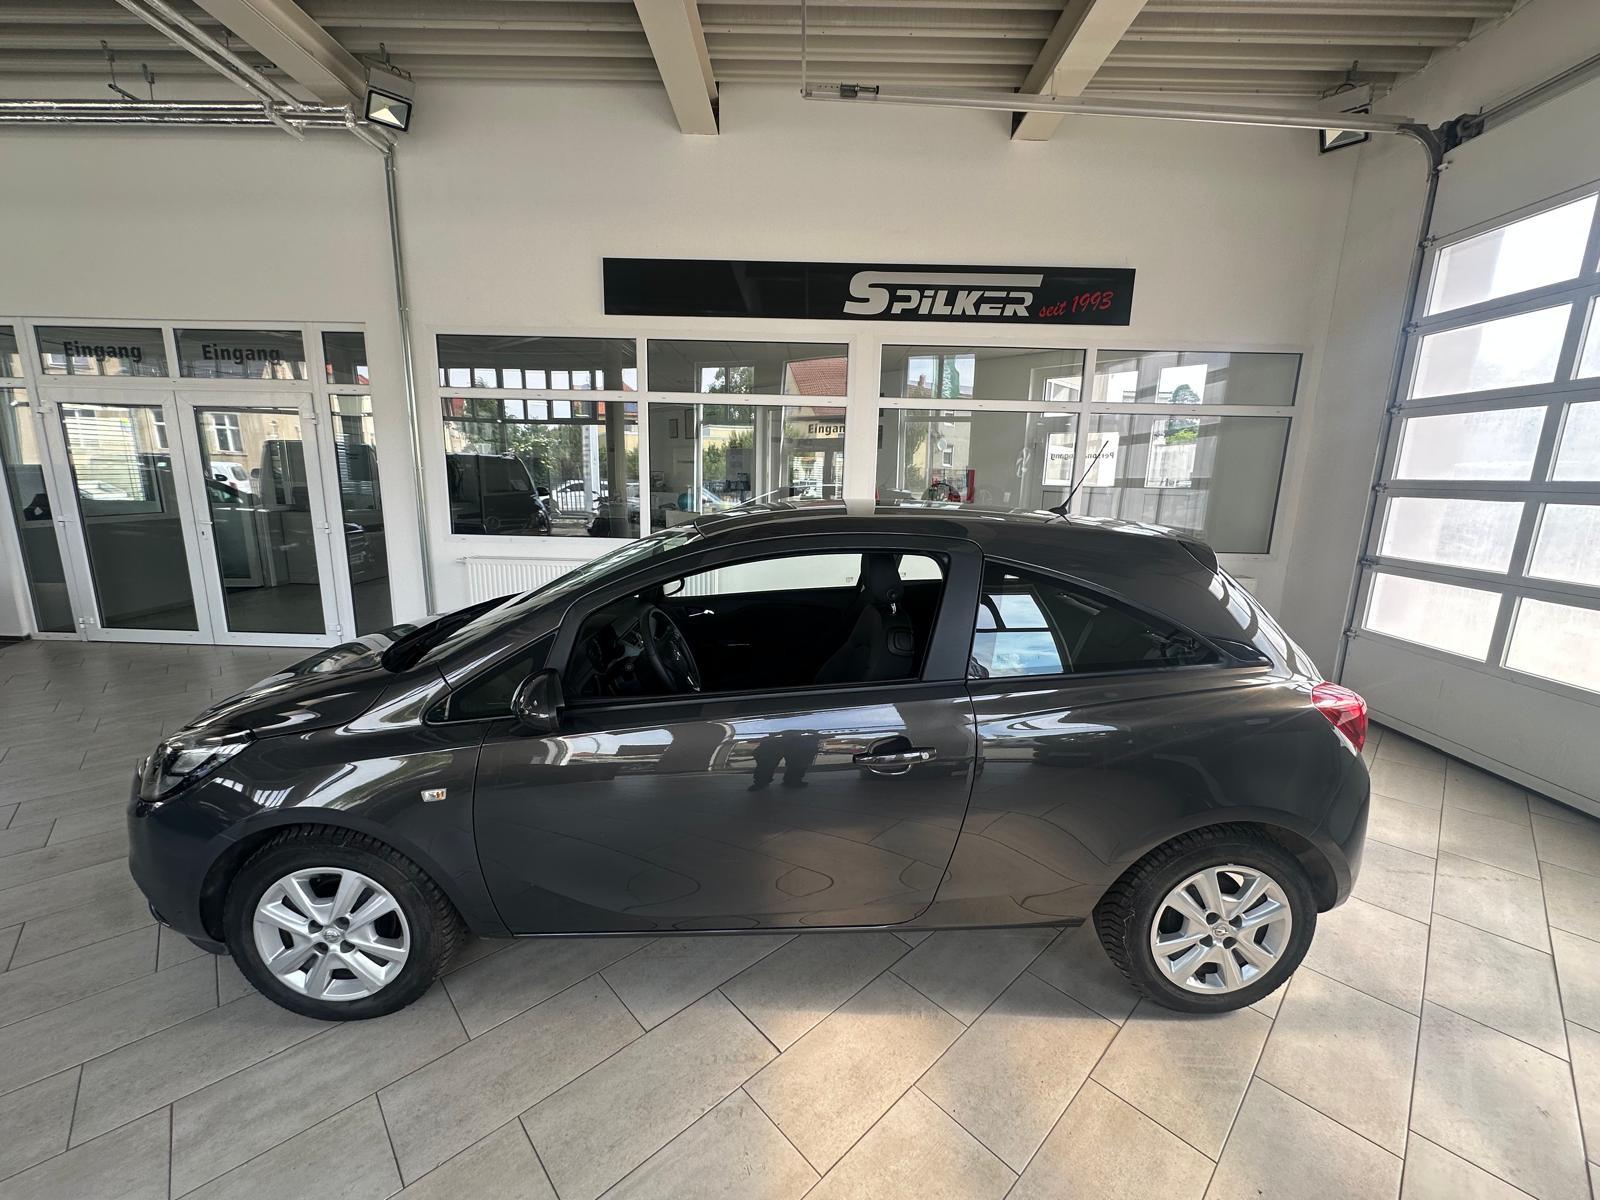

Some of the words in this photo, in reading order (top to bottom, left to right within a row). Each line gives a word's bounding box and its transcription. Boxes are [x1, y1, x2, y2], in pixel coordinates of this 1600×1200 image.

[1038, 303, 1066, 318] seit
[1072, 291, 1114, 312] 1993
[63, 341, 142, 362] Eingang
[202, 344, 282, 365] Eingang
[808, 423, 846, 436] Eingan
